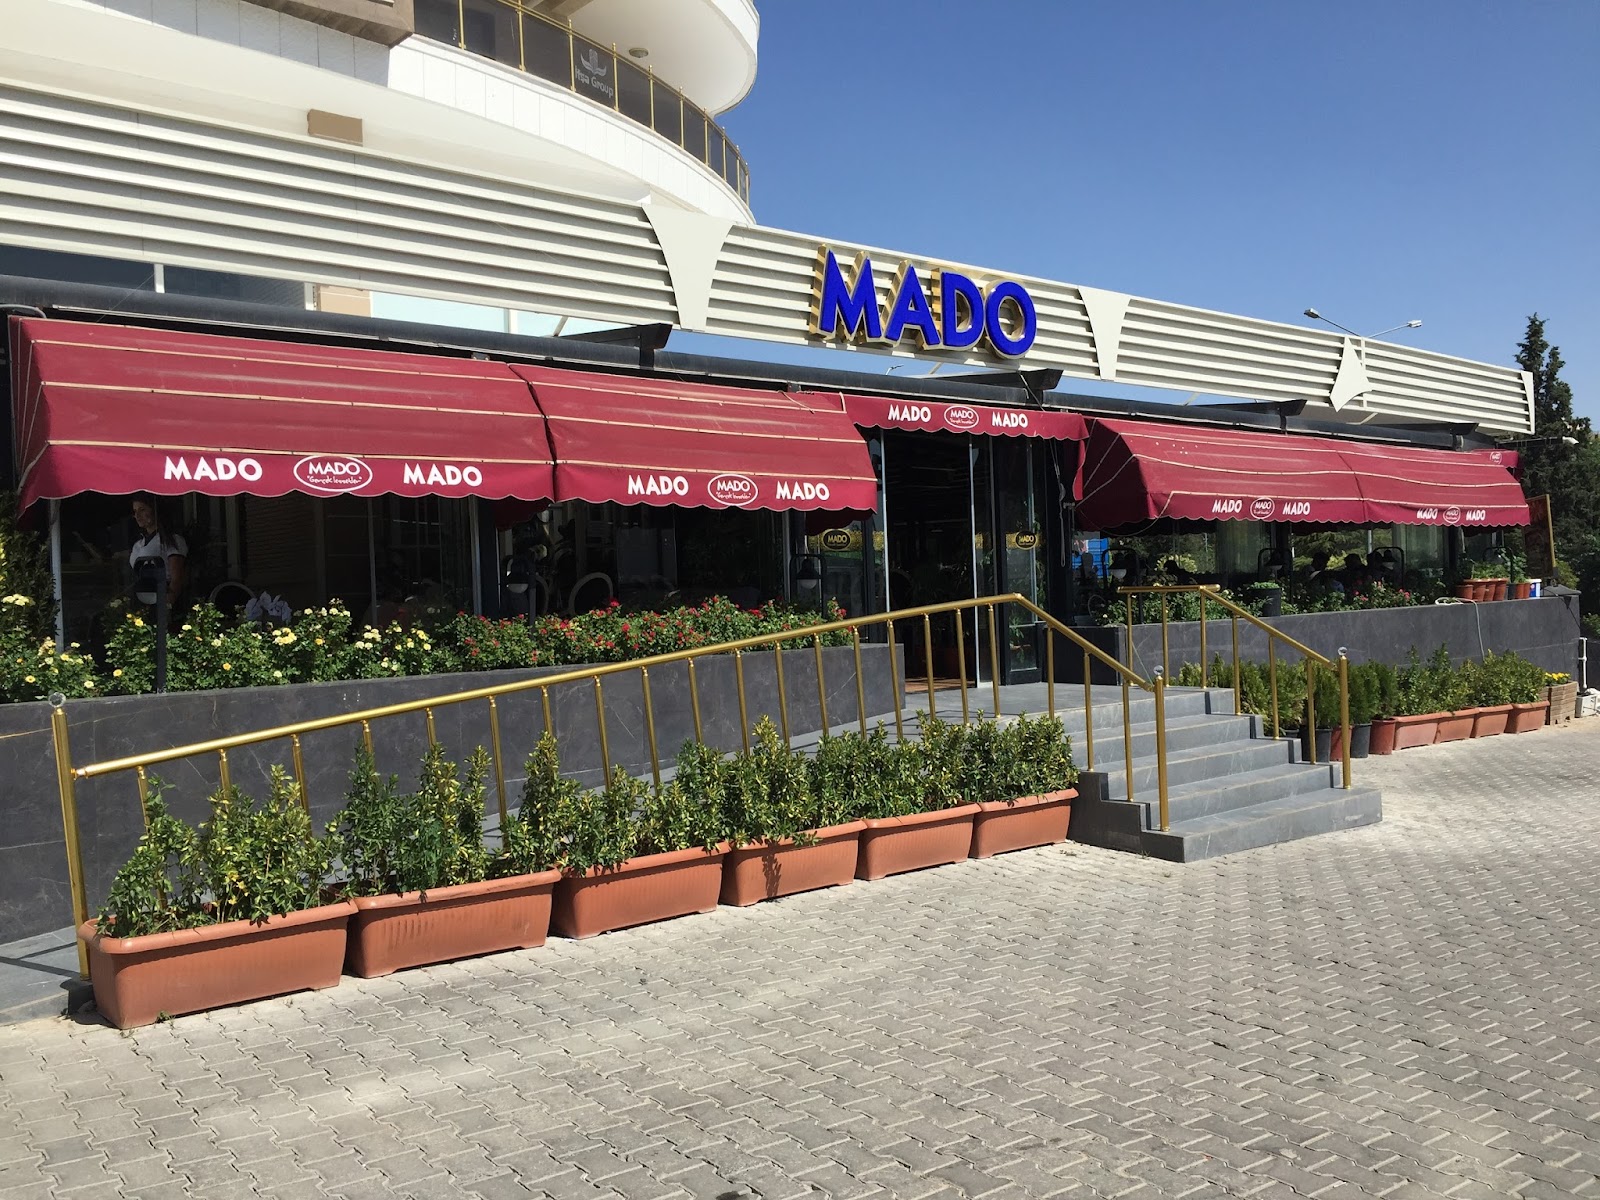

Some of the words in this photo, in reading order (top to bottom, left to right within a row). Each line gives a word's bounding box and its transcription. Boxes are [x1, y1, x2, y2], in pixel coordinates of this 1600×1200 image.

[591, 76, 614, 98] Group
[815, 246, 1037, 359] MADO
[887, 404, 932, 422] MADO
[950, 409, 974, 419] MADO
[991, 411, 1029, 428] MADO
[164, 456, 263, 481] MADO
[308, 462, 361, 475] MADO
[403, 463, 483, 487] MADO
[627, 475, 689, 496] MADO
[717, 480, 751, 492] MADO
[776, 481, 830, 500] MADO
[1212, 500, 1243, 513] MADO
[1254, 501, 1272, 509] MADO
[1282, 502, 1311, 515] MADO
[1416, 508, 1438, 519] MADO
[1465, 509, 1486, 520] MADO
[827, 534, 848, 543] MADO
